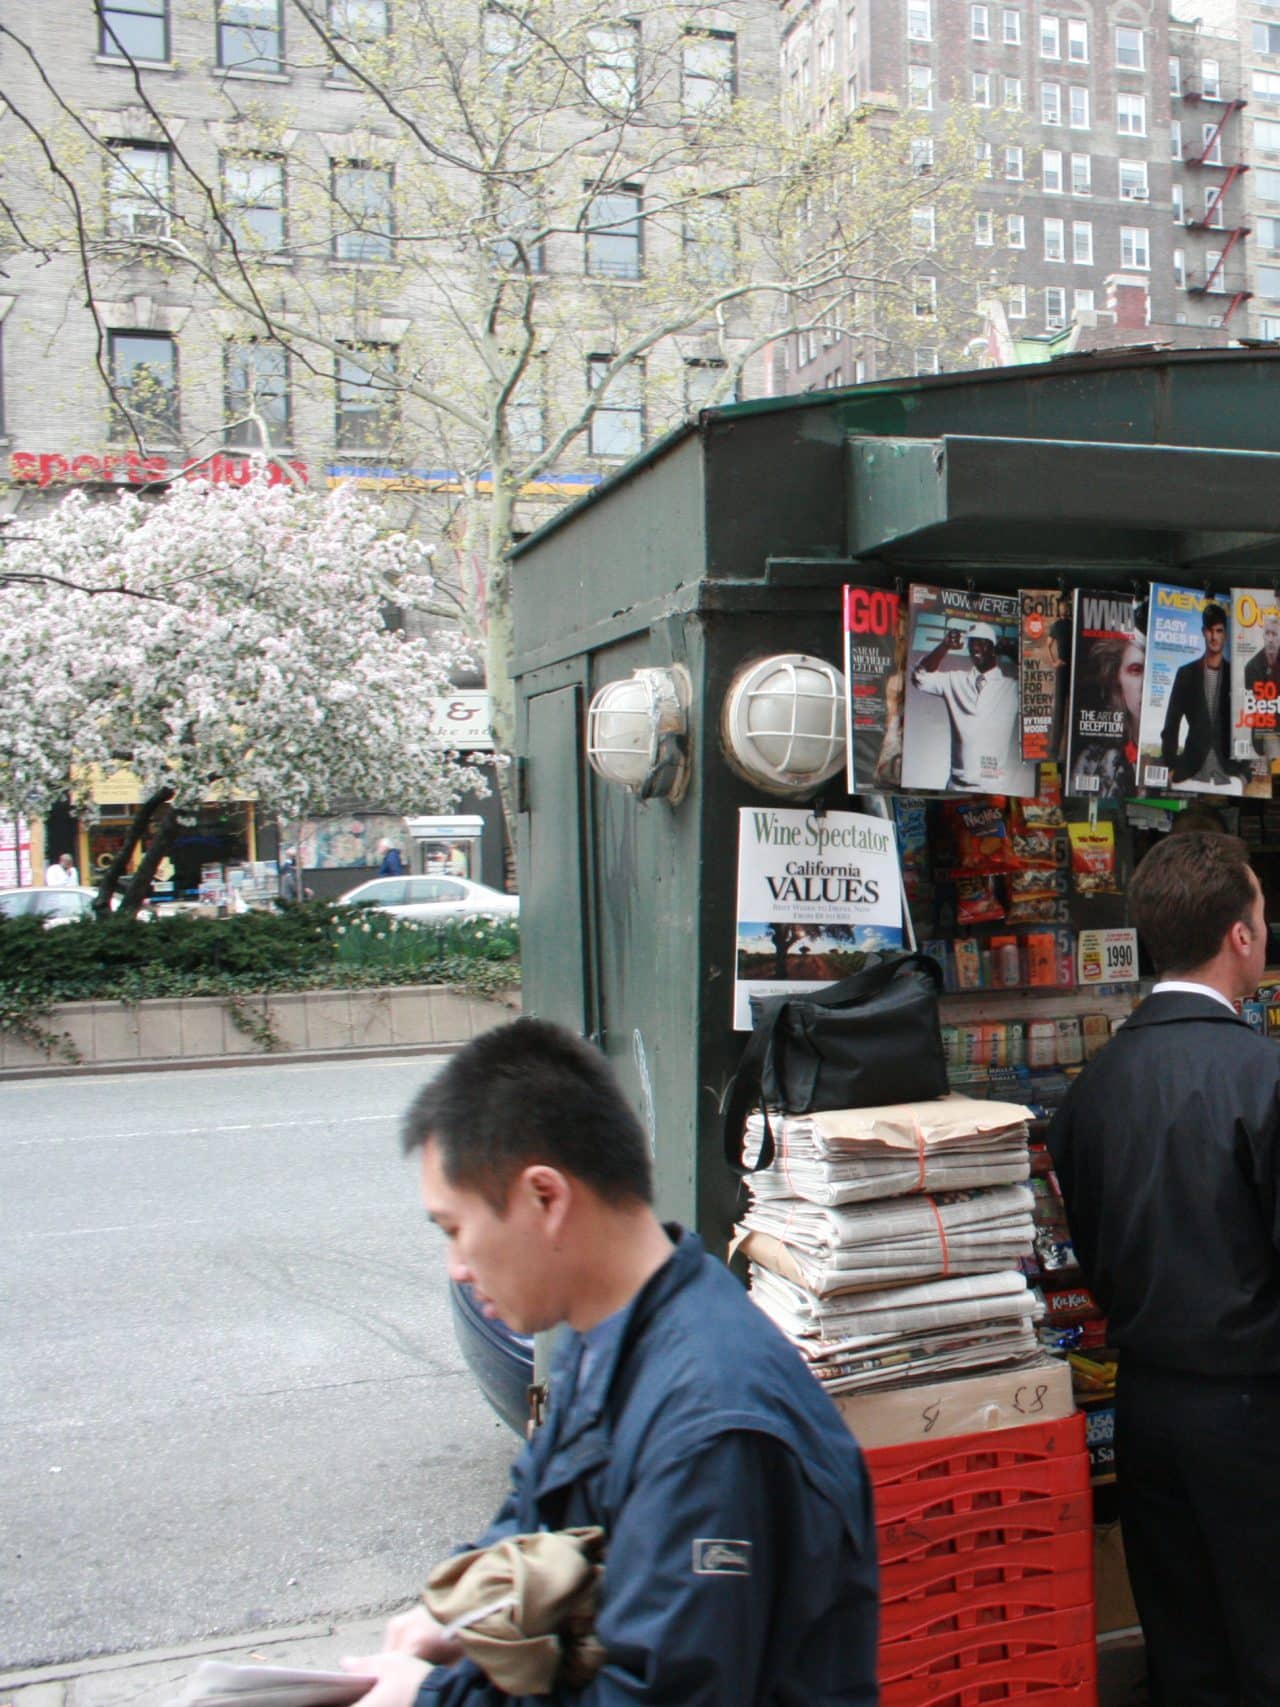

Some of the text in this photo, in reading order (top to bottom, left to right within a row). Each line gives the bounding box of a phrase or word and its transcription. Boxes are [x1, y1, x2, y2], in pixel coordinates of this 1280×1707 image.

[11, 451, 170, 488] sports
[1022, 595, 1057, 619] Golf
[1154, 618, 1188, 632] EASY
[1153, 632, 1188, 646] DOES
[1189, 635, 1200, 648] IT
[1032, 671, 1055, 683] KEYS
[1023, 684, 1043, 694] FOR
[1252, 682, 1278, 701] 50
[1023, 695, 1054, 706] EVERY
[447, 702, 482, 721] &
[1080, 710, 1125, 722] THE ART OF
[1235, 709, 1277, 730] Jobs
[1080, 720, 1124, 734] DECEPTION
[752, 811, 890, 857] Wine Spectator
[784, 859, 861, 878] California
[763, 875, 880, 904] VALUES
[1105, 944, 1134, 969] 1990
[1087, 1413, 1115, 1427] USA
[1087, 1426, 1116, 1444] ODAY
